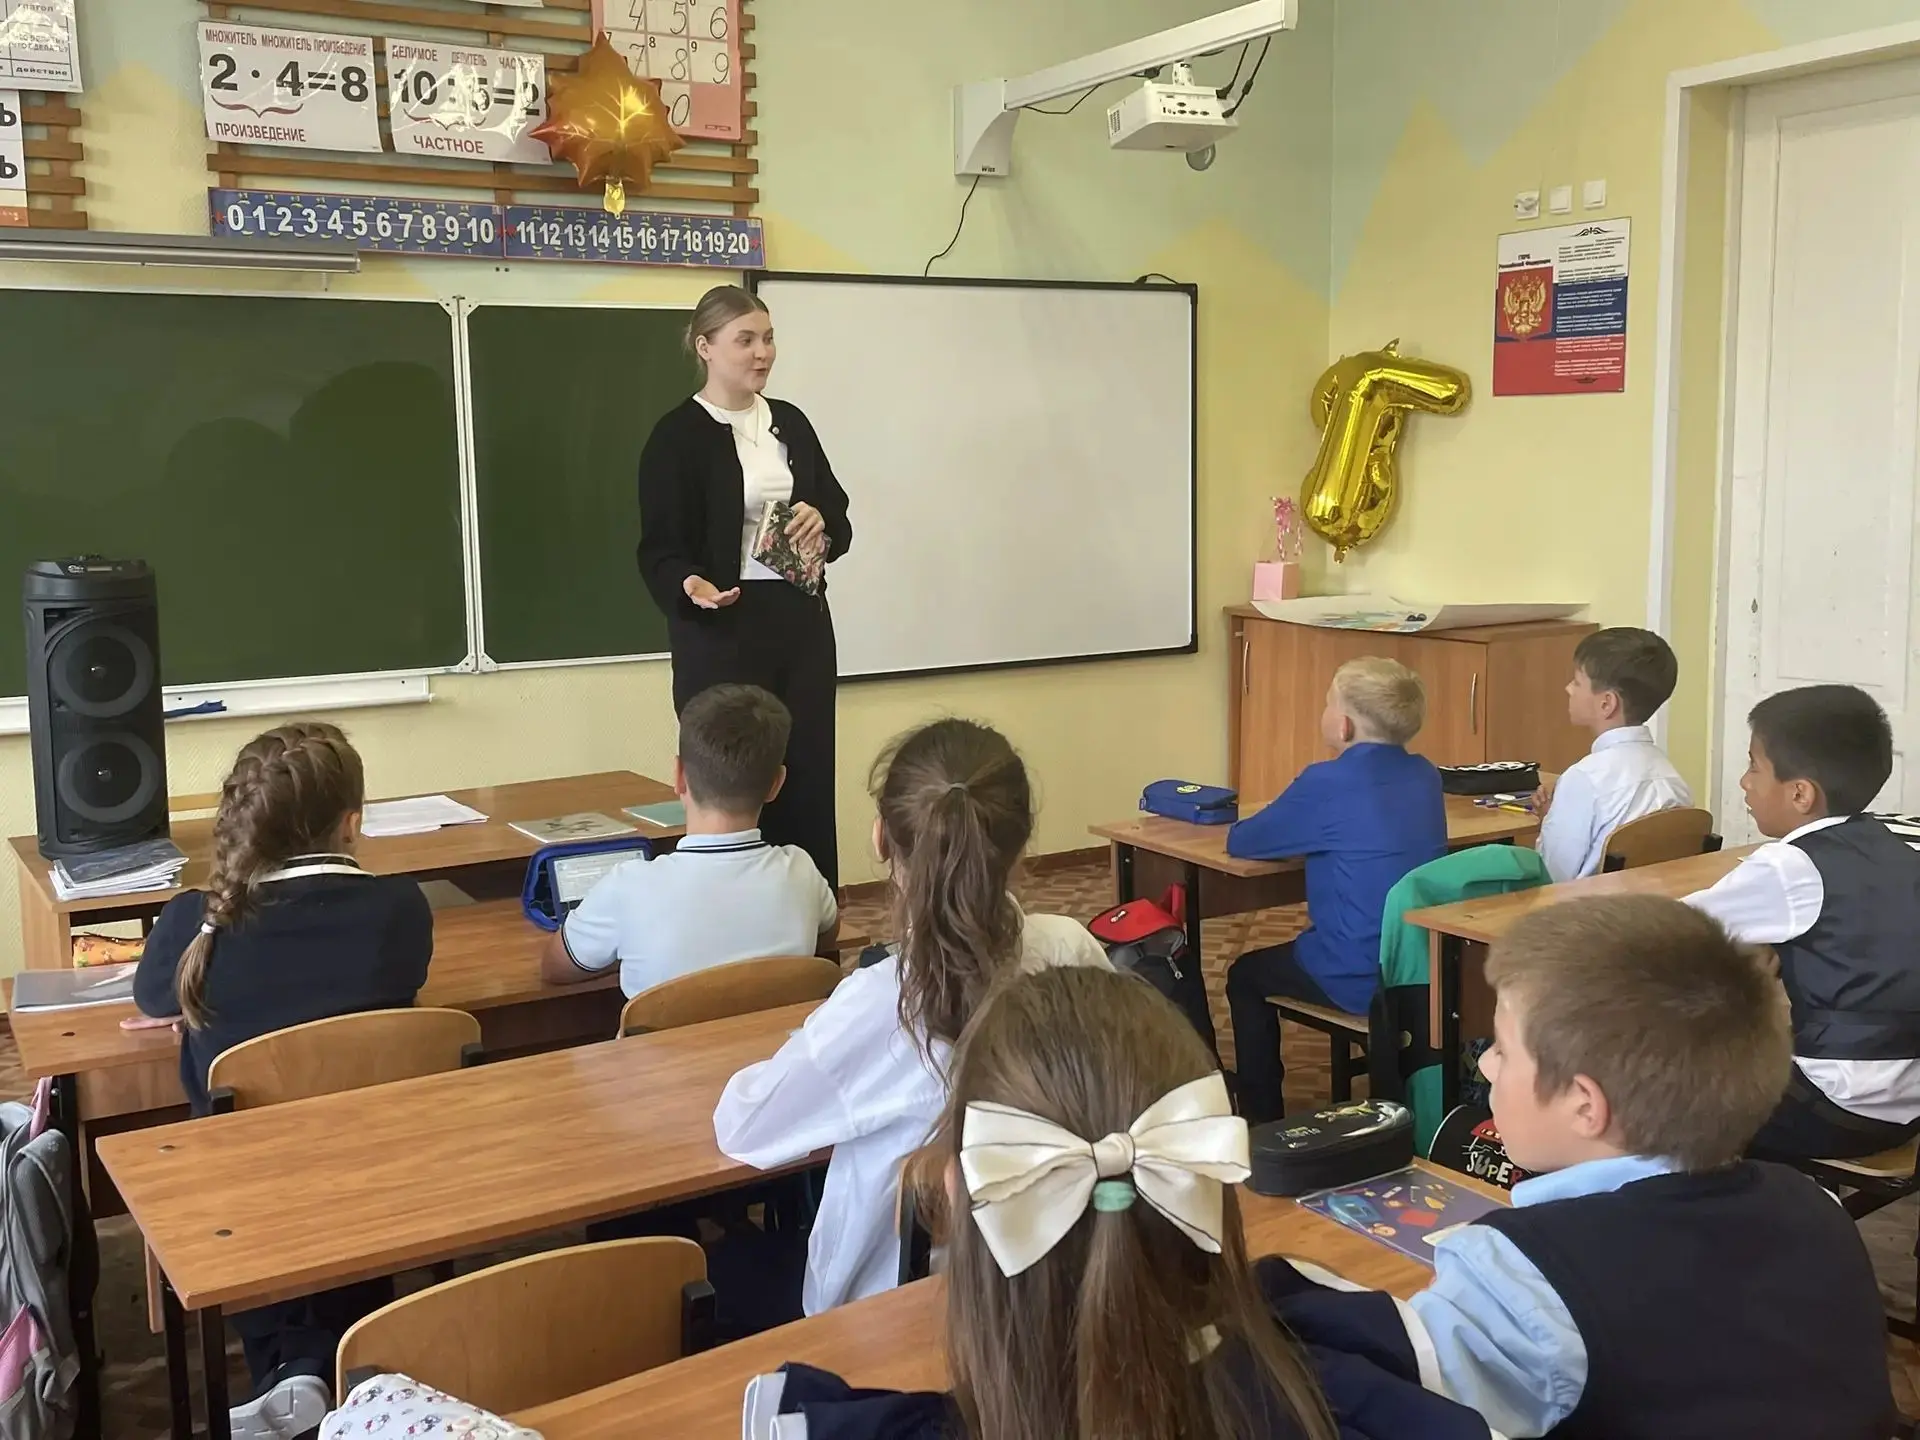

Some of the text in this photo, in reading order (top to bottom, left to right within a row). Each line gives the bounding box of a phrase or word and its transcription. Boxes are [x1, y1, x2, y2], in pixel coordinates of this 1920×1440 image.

[670, 1, 687, 35] 5
[710, 7, 728, 39] 6
[206, 29, 367, 56] МНОЖИТЕЛЬ МНОЖИТЕЛЬ ПРОИЗВЕДЕНИЕ
[391, 45, 438, 62] ДЕЛИМОЕ
[451, 52, 488, 66] ДЕЛИТЕЛЬ
[648, 36, 656, 48] 8
[690, 41, 698, 53] 9
[629, 43, 646, 76] 7
[670, 48, 688, 80] 8
[712, 52, 729, 84] 9
[671, 94, 690, 127] 0
[216, 122, 306, 142] ПРОИЗВЕДЕНИЕ
[414, 135, 485, 154] ЧАСТНОЕ
[227, 204, 494, 244] 0 1 2 3 4 5 6 7 8 9 10
[517, 221, 749, 254] 11 12 13 14 15 16 17 18 19 20
